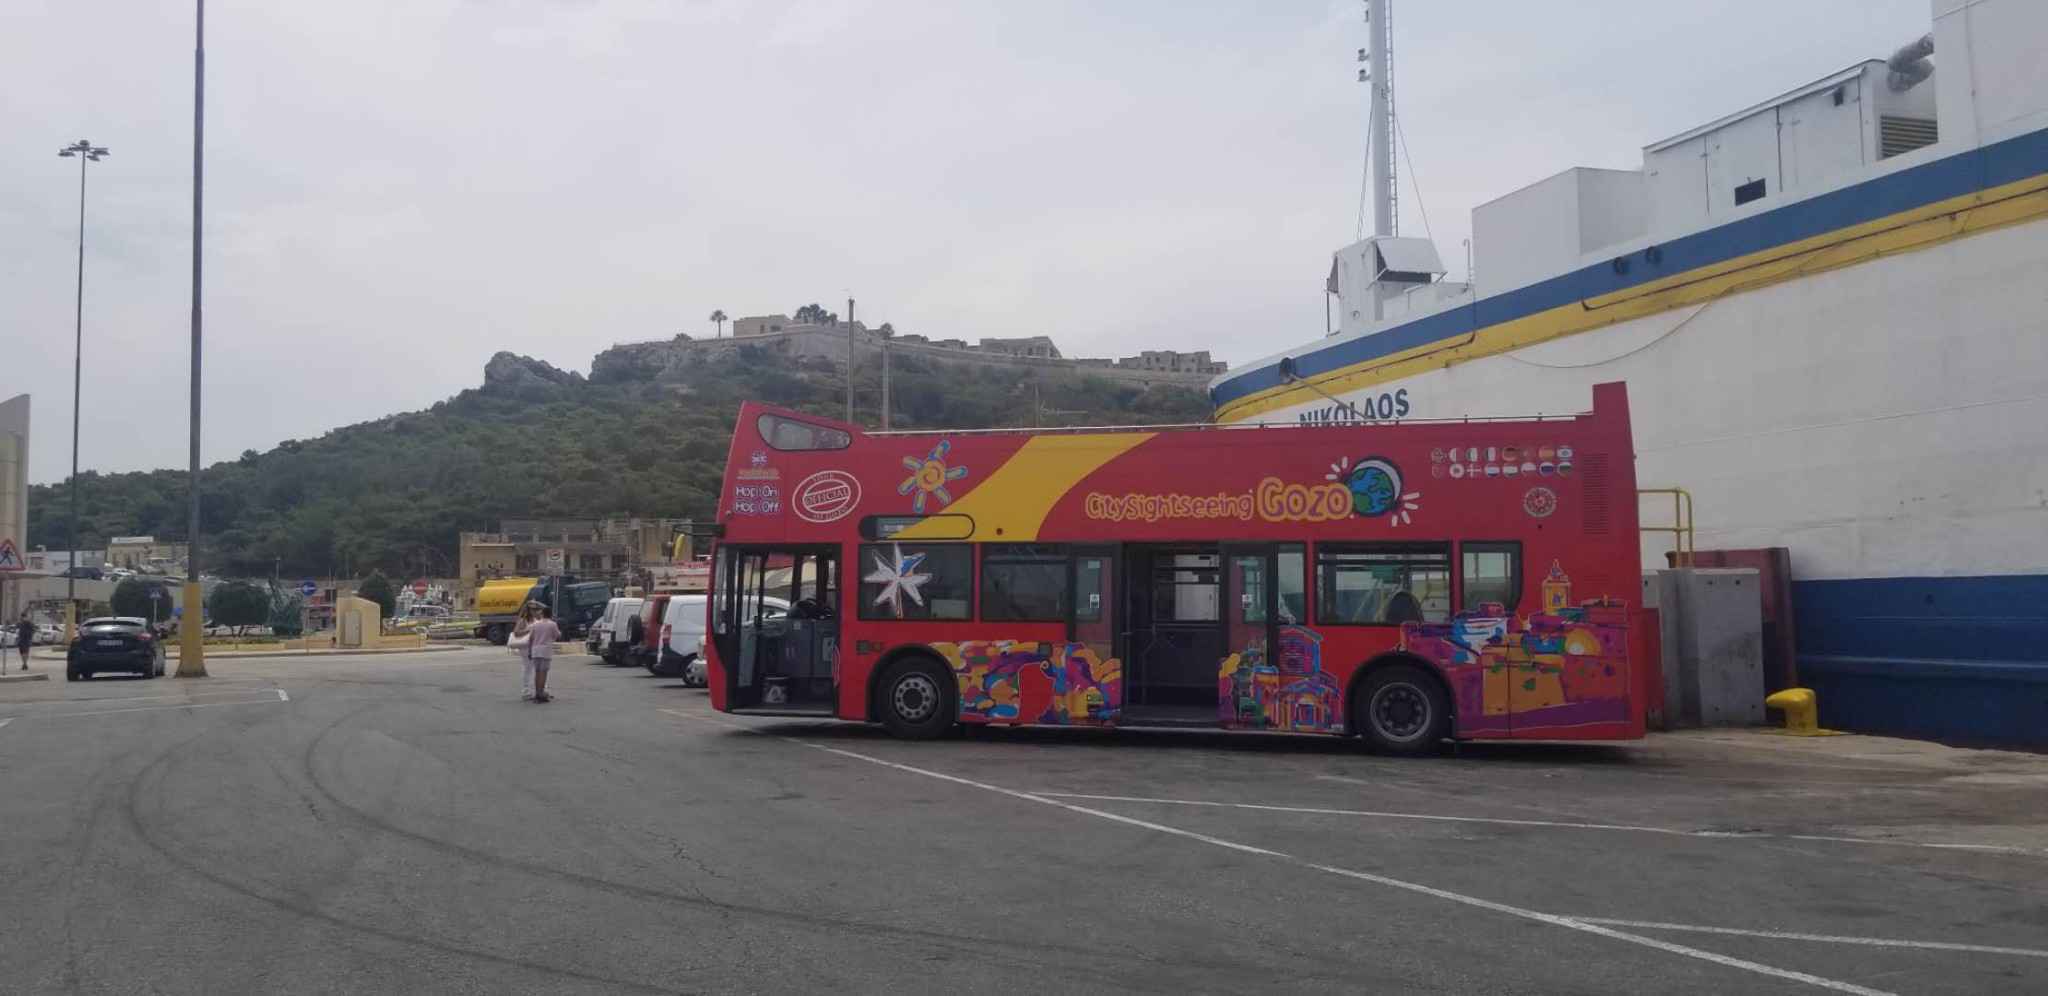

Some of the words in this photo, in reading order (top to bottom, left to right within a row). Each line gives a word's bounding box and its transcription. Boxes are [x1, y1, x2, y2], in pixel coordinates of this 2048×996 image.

[1299, 388, 1410, 425] NIKOLAOS
[1086, 491, 1255, 521] CitySightseeing
[1256, 476, 1353, 522] Gozo
